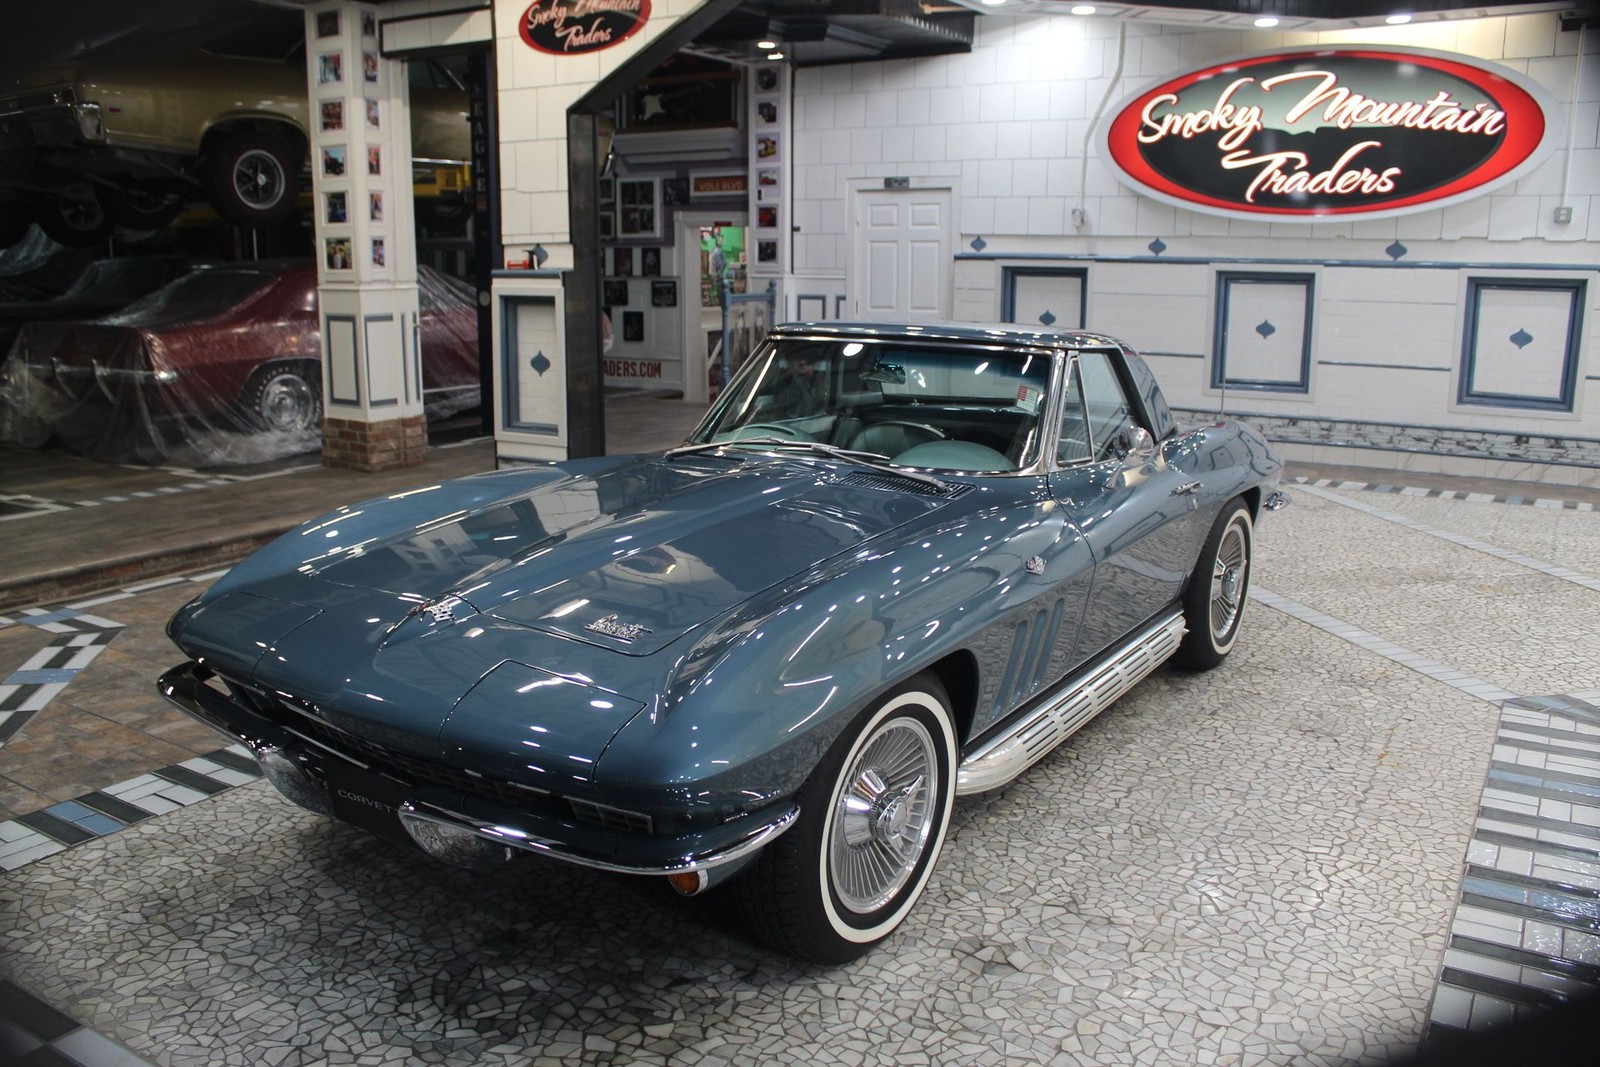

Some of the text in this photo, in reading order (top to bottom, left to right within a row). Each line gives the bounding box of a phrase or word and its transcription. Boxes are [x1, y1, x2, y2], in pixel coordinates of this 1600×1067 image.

[527, 0, 567, 30] Smoky
[555, 17, 613, 51] Traders
[1138, 71, 1506, 151] Smoky Mountain
[1222, 141, 1401, 203] Traders
[603, 360, 662, 378] ADERS.COM
[337, 789, 398, 813] CORVET
